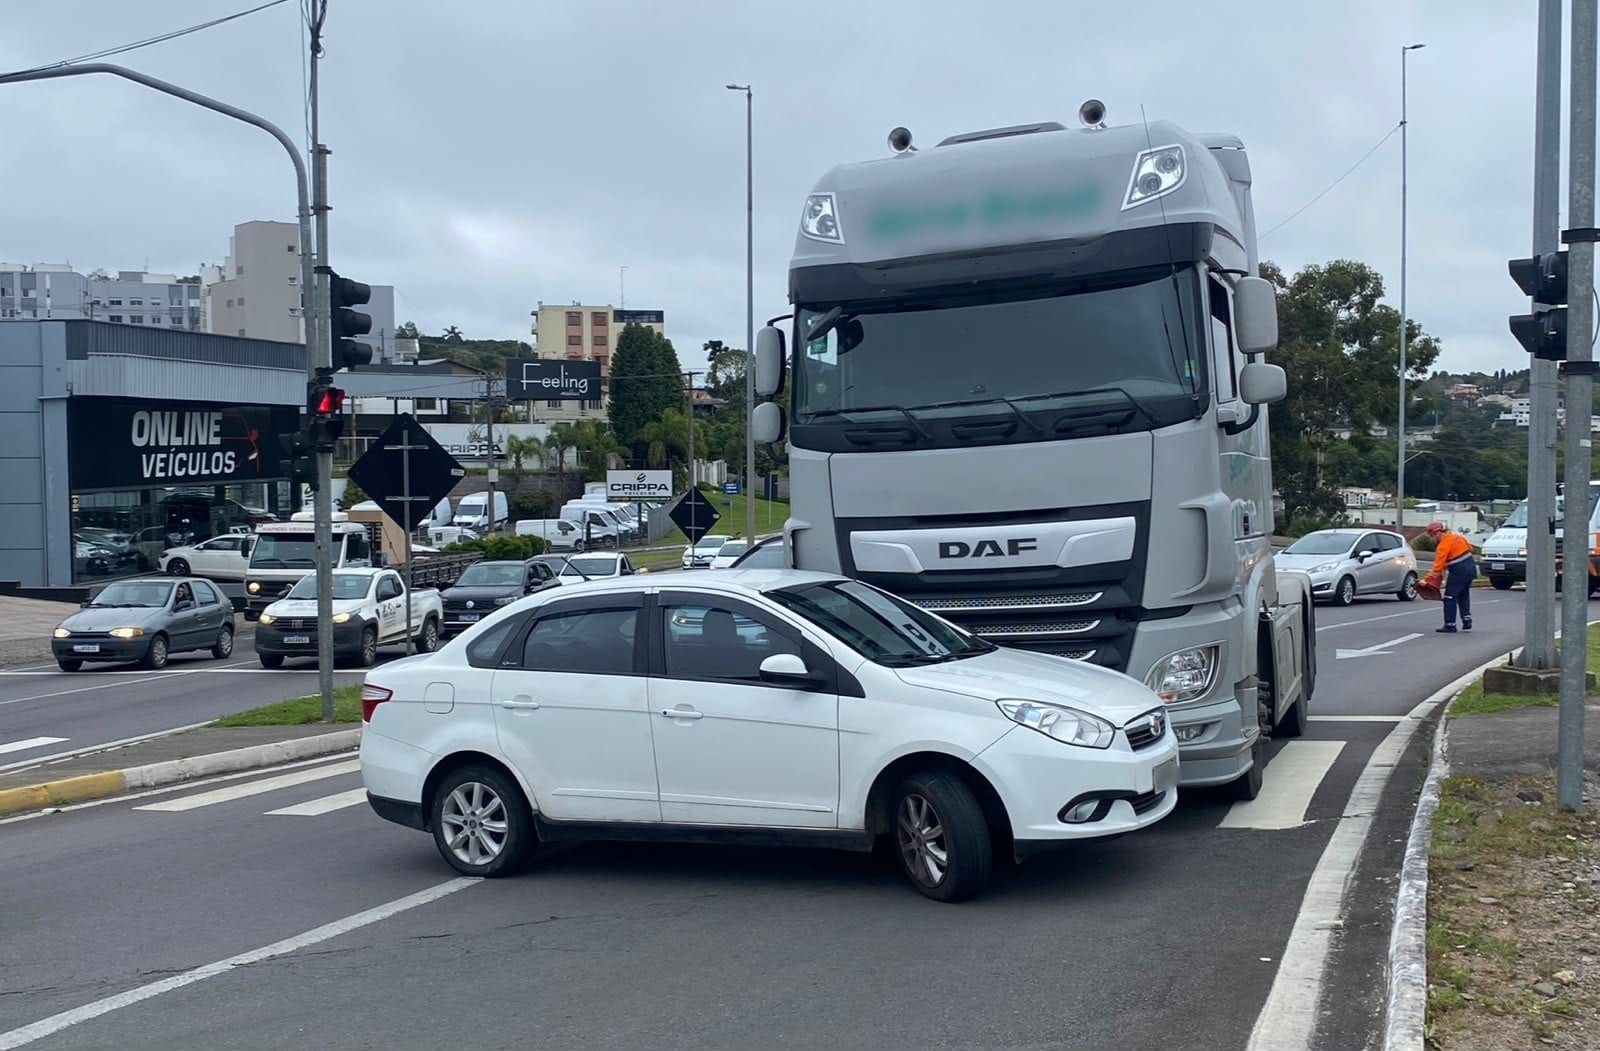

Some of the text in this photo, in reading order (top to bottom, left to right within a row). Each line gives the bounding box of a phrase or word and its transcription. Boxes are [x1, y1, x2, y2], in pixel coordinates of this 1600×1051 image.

[520, 363, 588, 394] Feeling
[131, 411, 223, 447] ONLINE
[142, 448, 236, 478] VEÍCULOS
[610, 483, 669, 491] CRIPPA
[939, 537, 1037, 559] DAF
